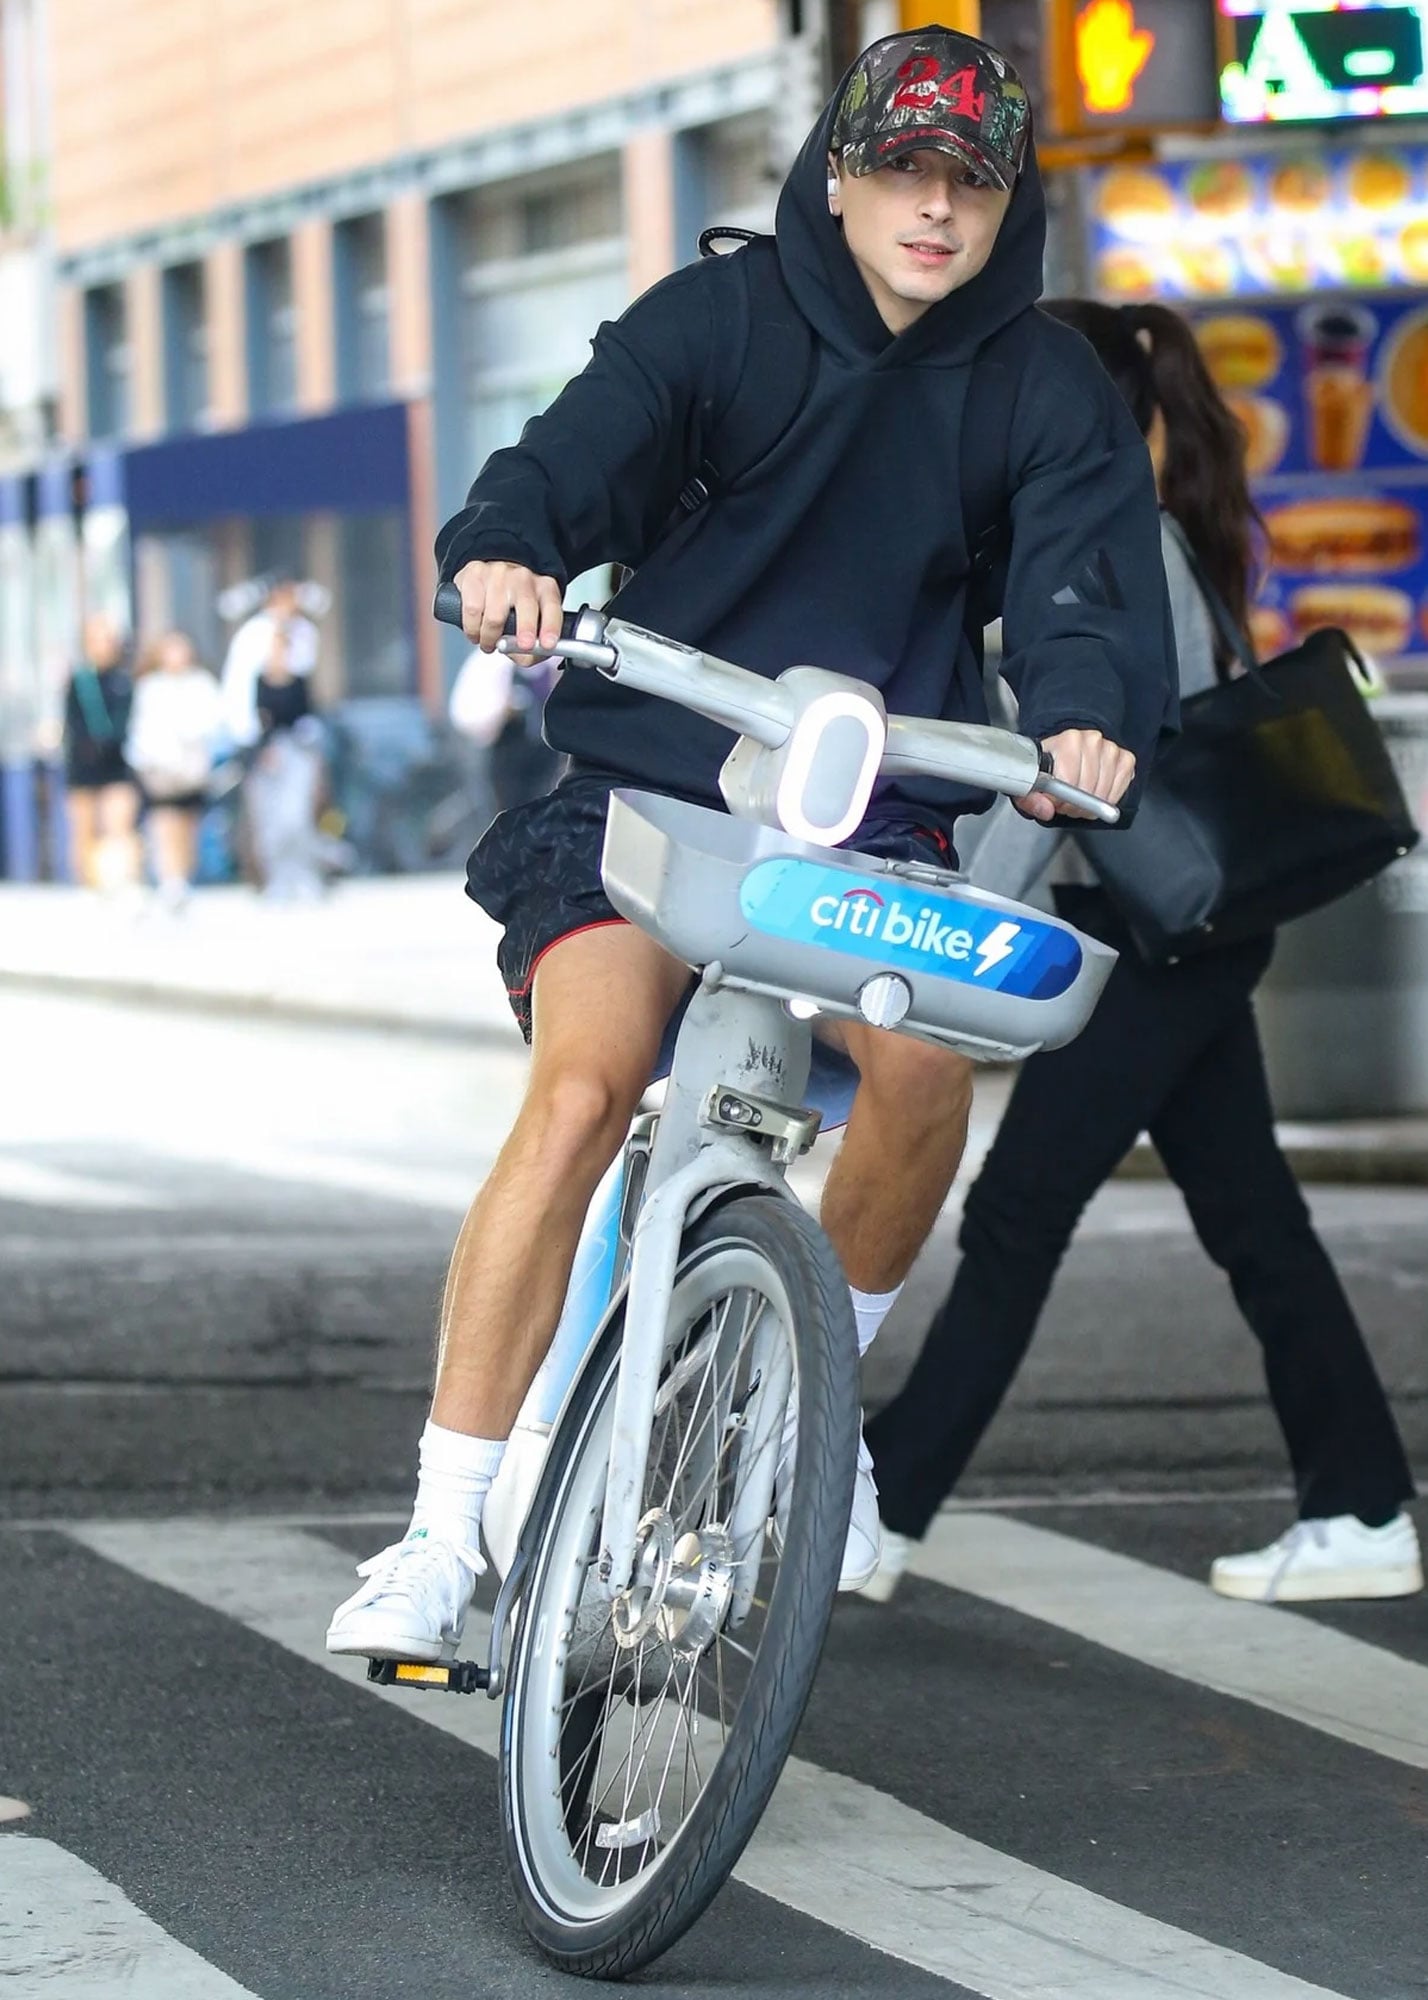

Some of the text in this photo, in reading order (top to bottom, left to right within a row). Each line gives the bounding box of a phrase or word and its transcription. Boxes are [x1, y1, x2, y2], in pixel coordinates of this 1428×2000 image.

[894, 55, 986, 122] 24
[810, 889, 974, 960] citi bike
